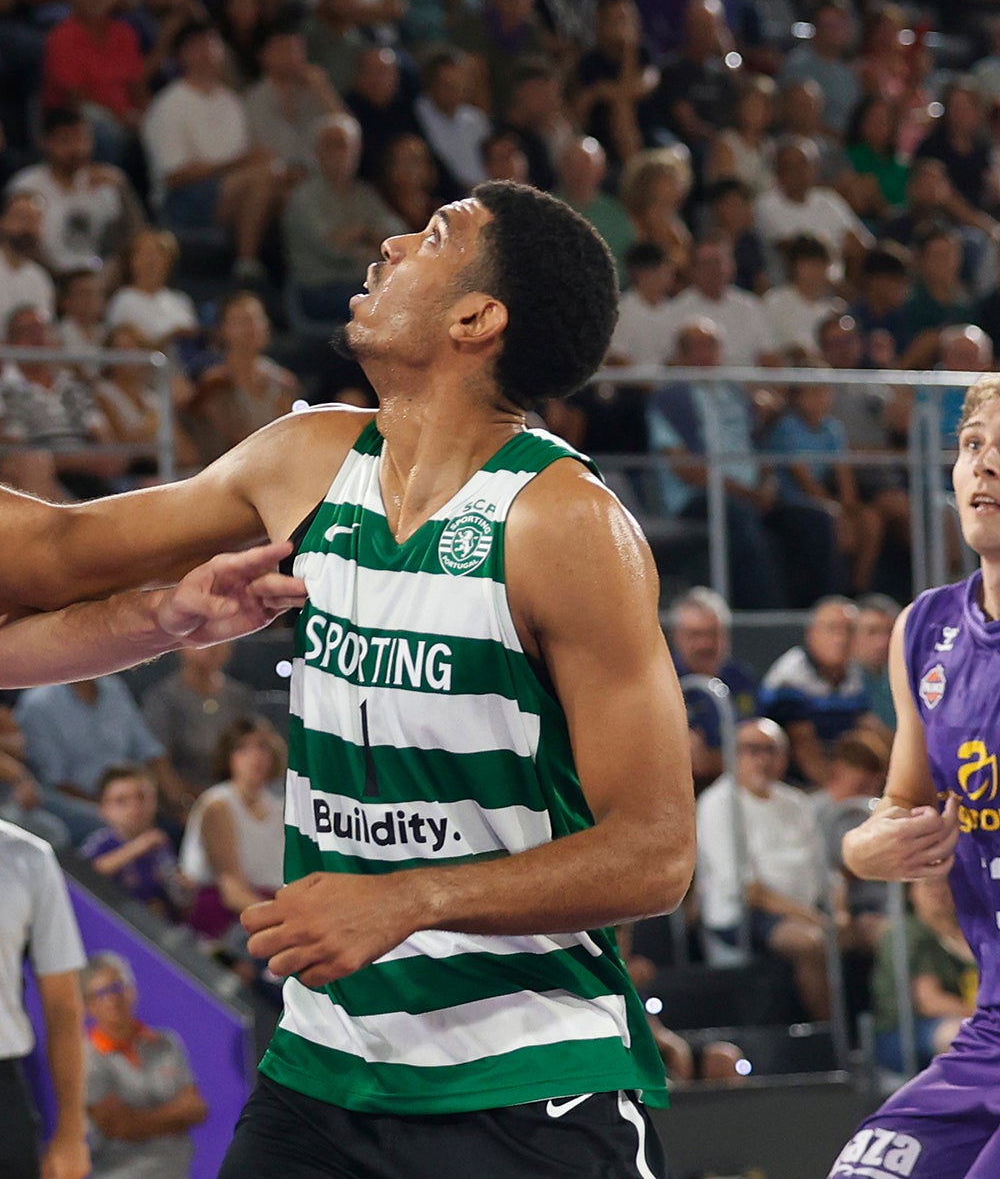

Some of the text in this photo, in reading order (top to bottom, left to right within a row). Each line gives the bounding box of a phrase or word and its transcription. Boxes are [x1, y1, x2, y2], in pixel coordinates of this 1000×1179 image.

[450, 515, 492, 535] SPORTING
[442, 555, 479, 569] PORTUGAL
[305, 614, 453, 691] SPORTING
[313, 798, 463, 852] Buildity.
